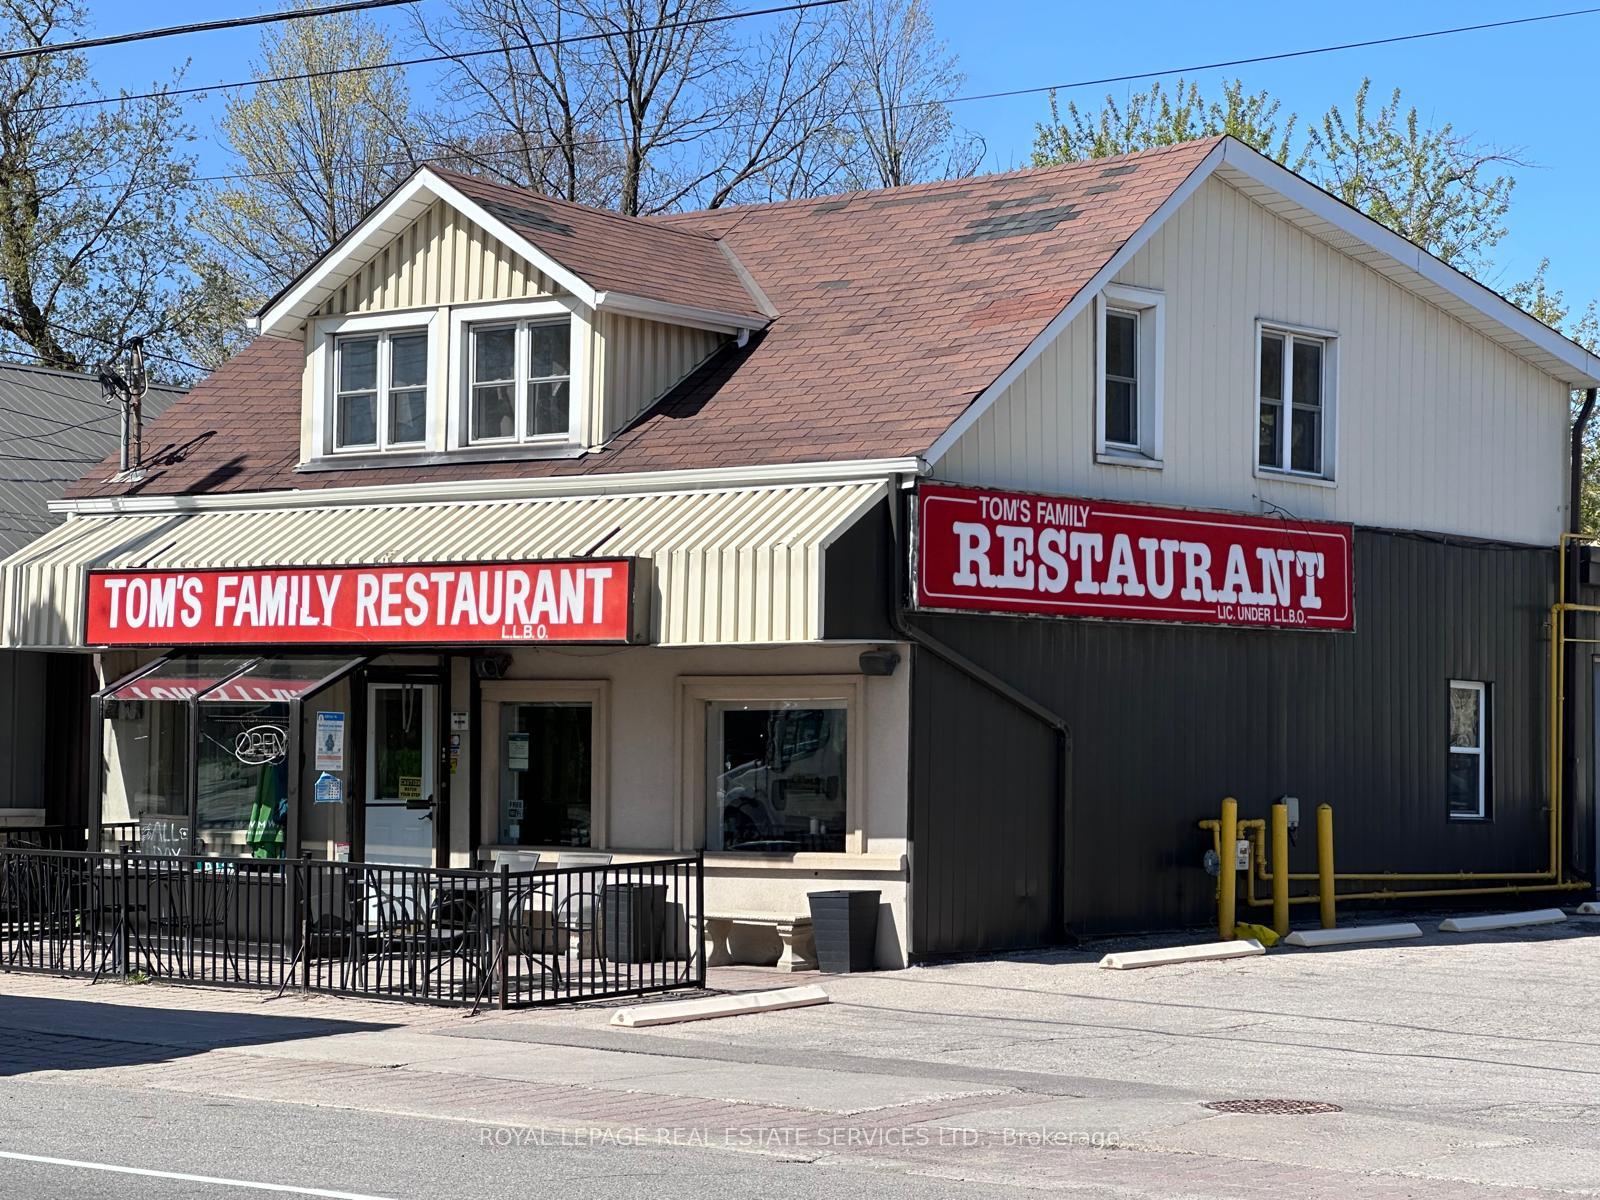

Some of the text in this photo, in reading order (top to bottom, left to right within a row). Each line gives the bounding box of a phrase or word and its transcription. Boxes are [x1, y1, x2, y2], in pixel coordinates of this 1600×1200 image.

[979, 496, 1090, 528] TOM'S FAMILY
[952, 521, 1325, 609] RESTAURANT
[104, 568, 613, 629] TOM'S FAMILY RESTAURANT
[1217, 605, 1307, 624] LIC. UNDER L.L.B.O.
